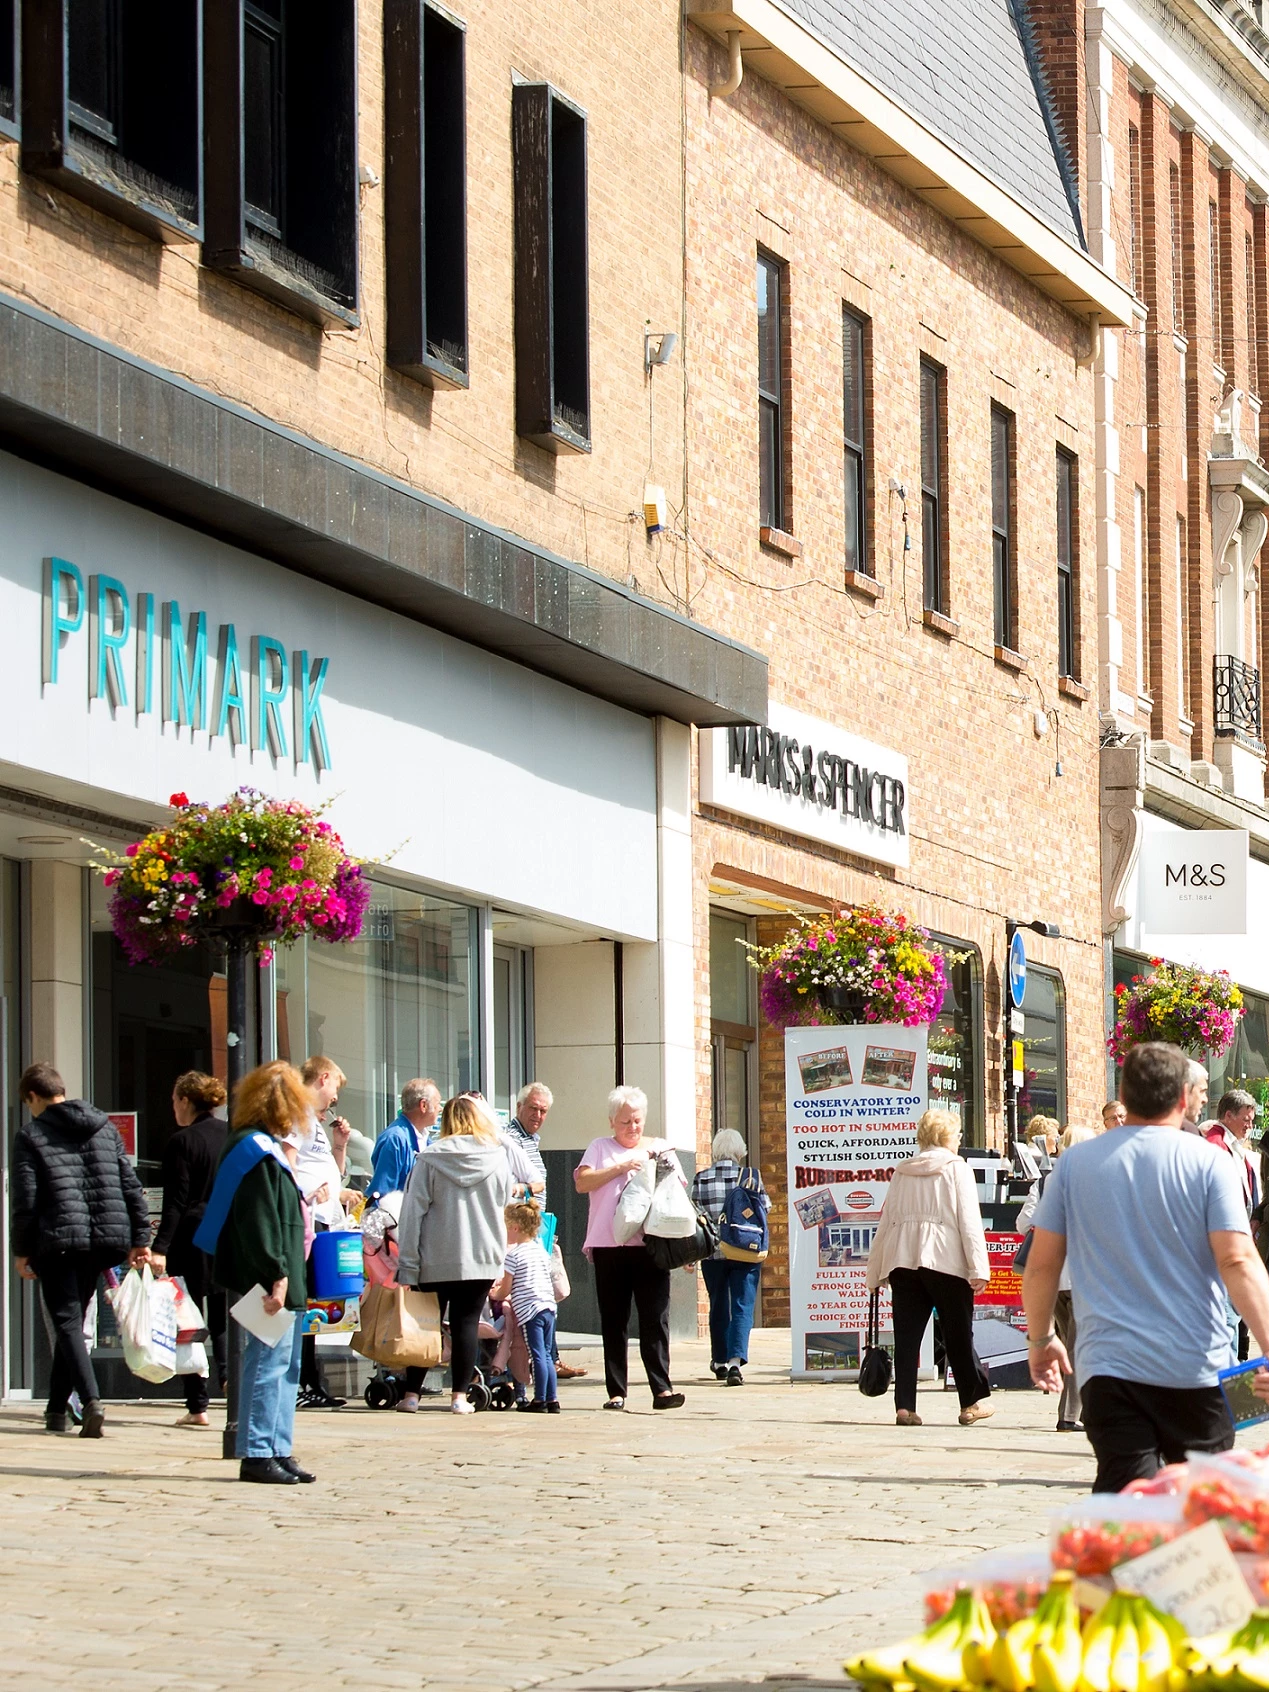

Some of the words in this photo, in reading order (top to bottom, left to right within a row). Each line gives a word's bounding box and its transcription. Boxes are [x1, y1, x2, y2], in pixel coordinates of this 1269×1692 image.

[41, 556, 333, 771] PRIMARK
[1165, 863, 1225, 887] M&S
[818, 1052, 846, 1060] BEFORE
[868, 1051, 895, 1059] AFTER
[793, 1097, 896, 1109] CONSERVATORY
[897, 1096, 921, 1105] TOO
[804, 1109, 837, 1118] COLD
[839, 1108, 854, 1117] IN
[856, 1107, 911, 1117] WINTER?
[793, 1125, 818, 1134] TOO
[821, 1124, 846, 1133] HOT
[849, 1123, 863, 1132] IN
[865, 1122, 919, 1132] SUMMER
[798, 1139, 839, 1151] QUICK,
[803, 1153, 852, 1163] STYLISH
[794, 1165, 896, 1189] RUBBER-IT-RO
[816, 1271, 847, 1279] FULLY
[811, 1282, 852, 1290] STRONG
[838, 1290, 868, 1298] WALK
[820, 1301, 848, 1309] YEAR
[809, 1313, 847, 1321] CHOICE
